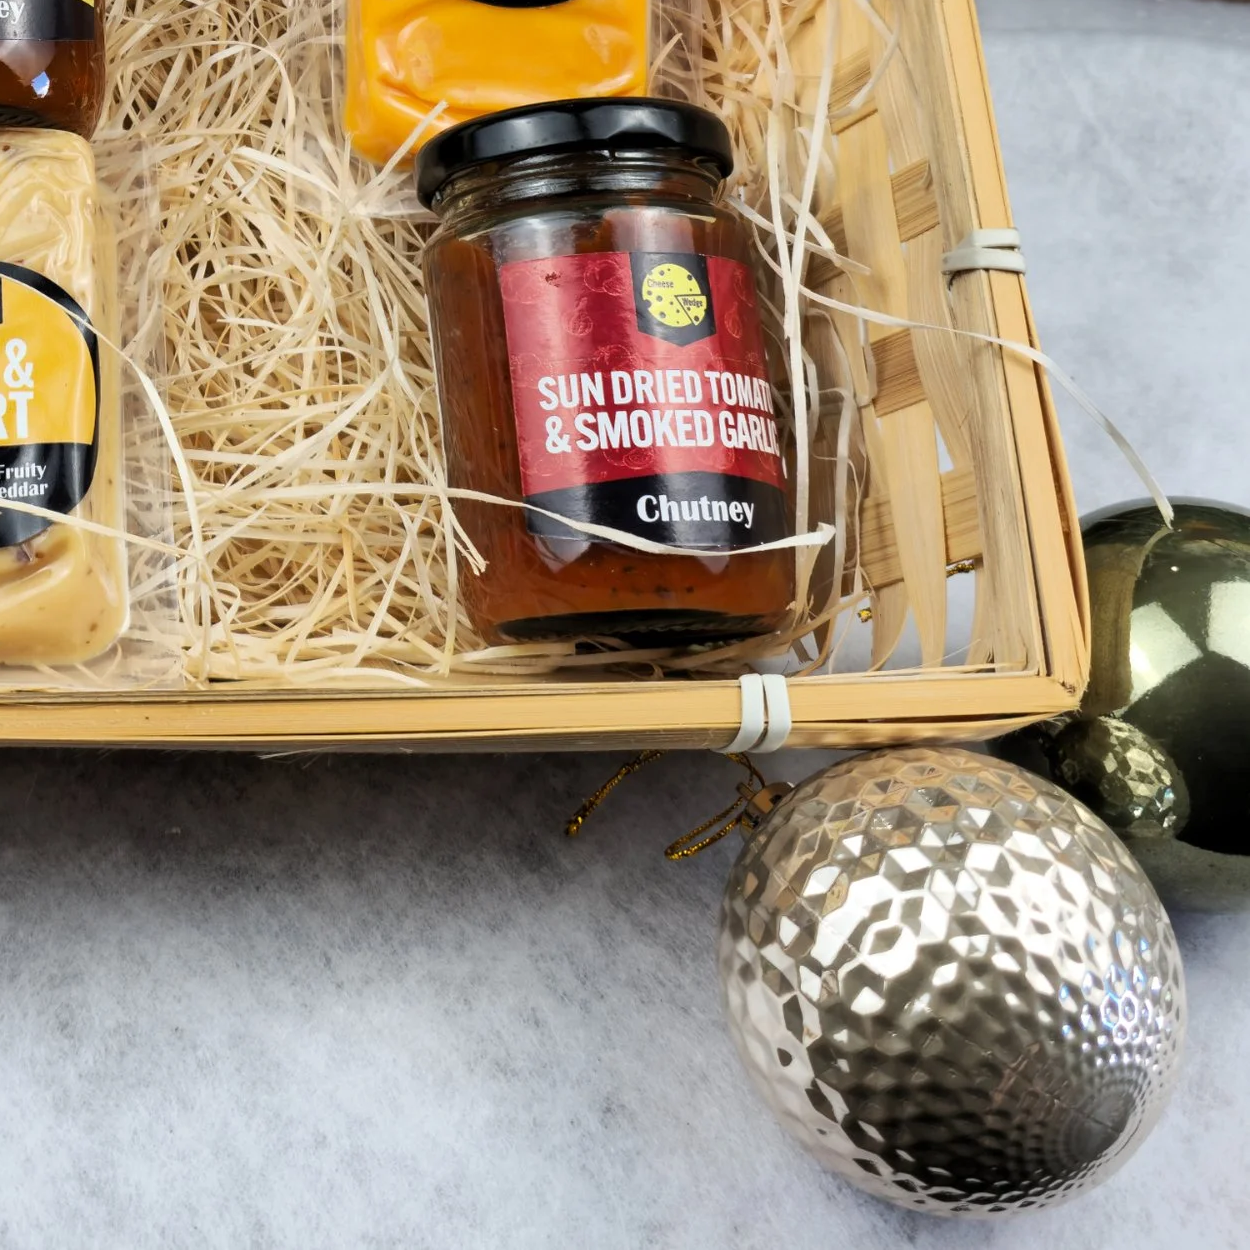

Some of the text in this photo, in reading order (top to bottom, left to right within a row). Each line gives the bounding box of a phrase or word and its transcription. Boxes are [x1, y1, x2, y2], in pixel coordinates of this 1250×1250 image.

[3, 338, 34, 389] &
[538, 372, 605, 412] SUN
[611, 369, 701, 405] DRIED
[545, 416, 572, 455] &
[574, 409, 715, 451] SMOKED
[636, 494, 756, 529] Chutney
